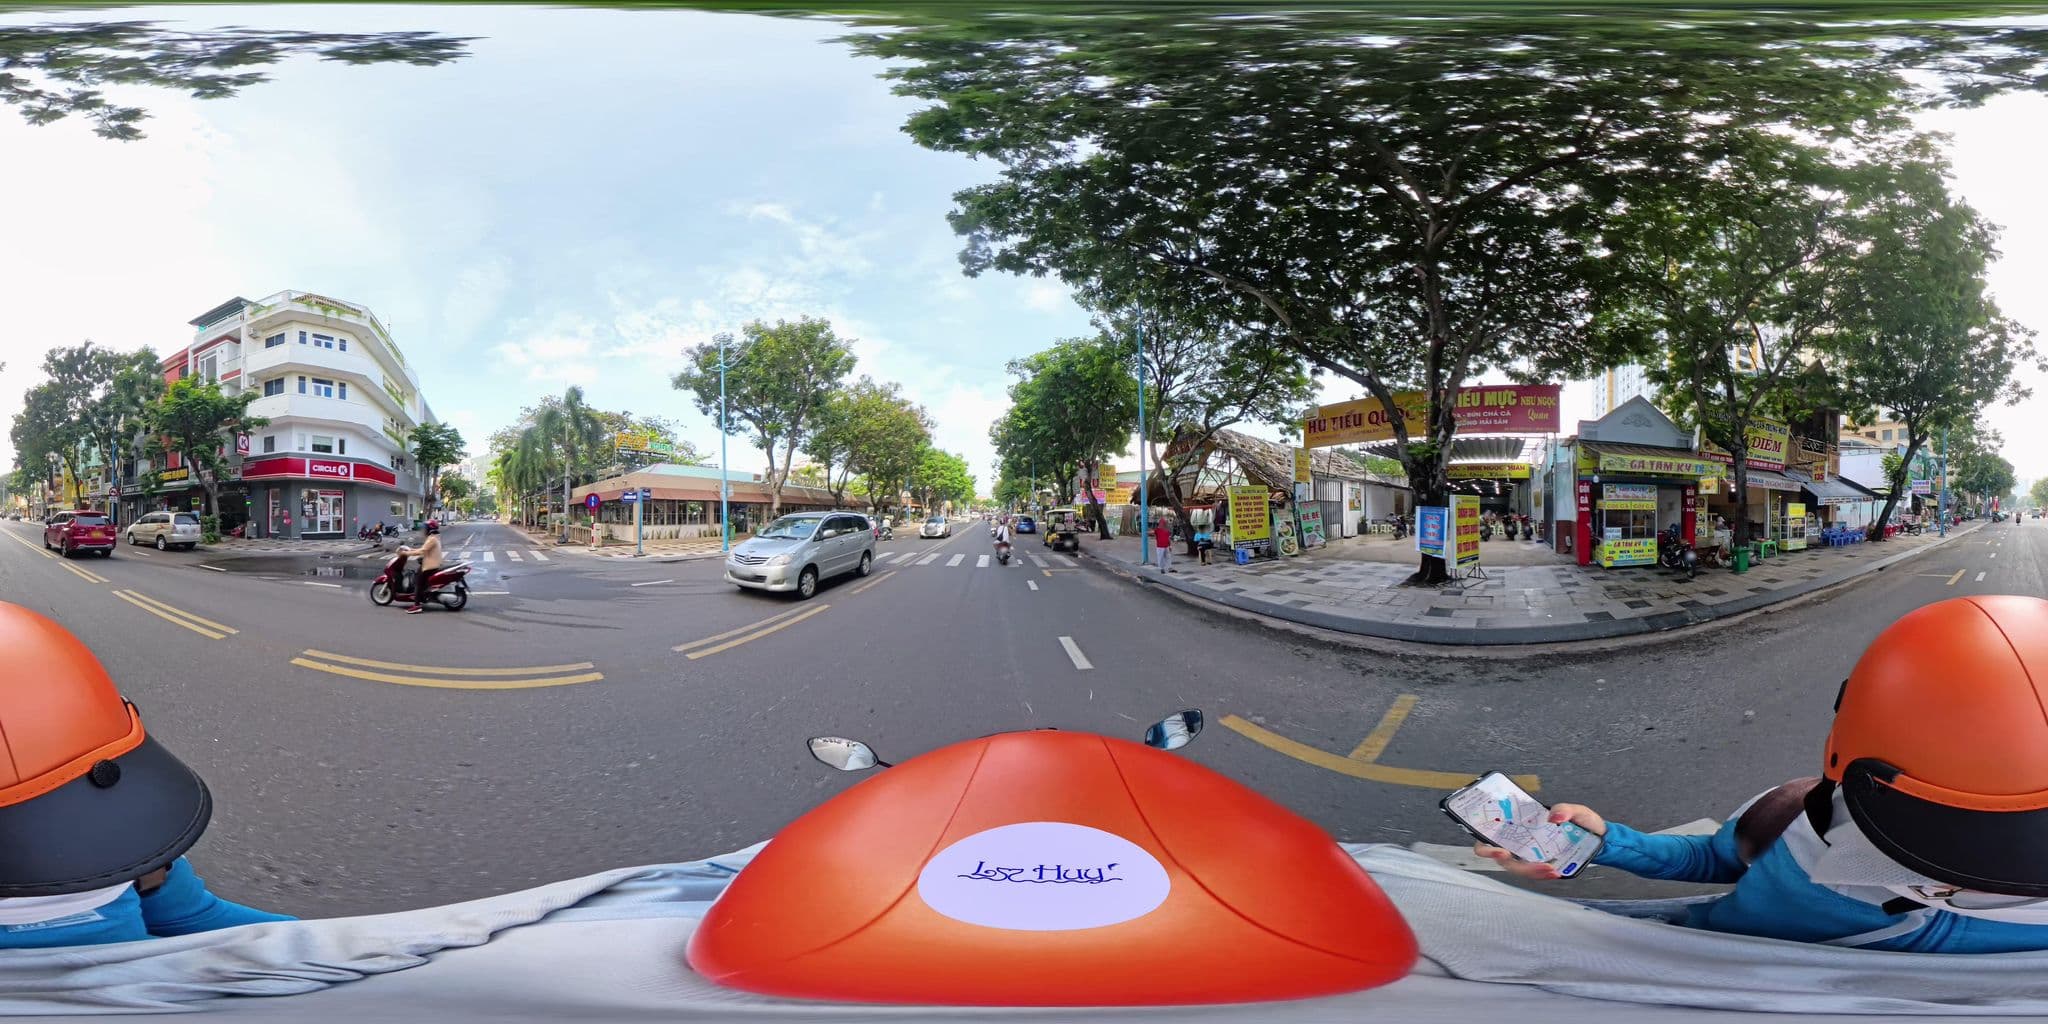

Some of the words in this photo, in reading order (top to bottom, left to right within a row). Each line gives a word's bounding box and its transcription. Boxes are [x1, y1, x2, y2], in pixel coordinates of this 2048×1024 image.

[1457, 389, 1480, 407] IẾU
[1484, 389, 1517, 408] MỰC
[1332, 409, 1363, 431] TIẾU
[312, 464, 337, 473] CIRCLE
